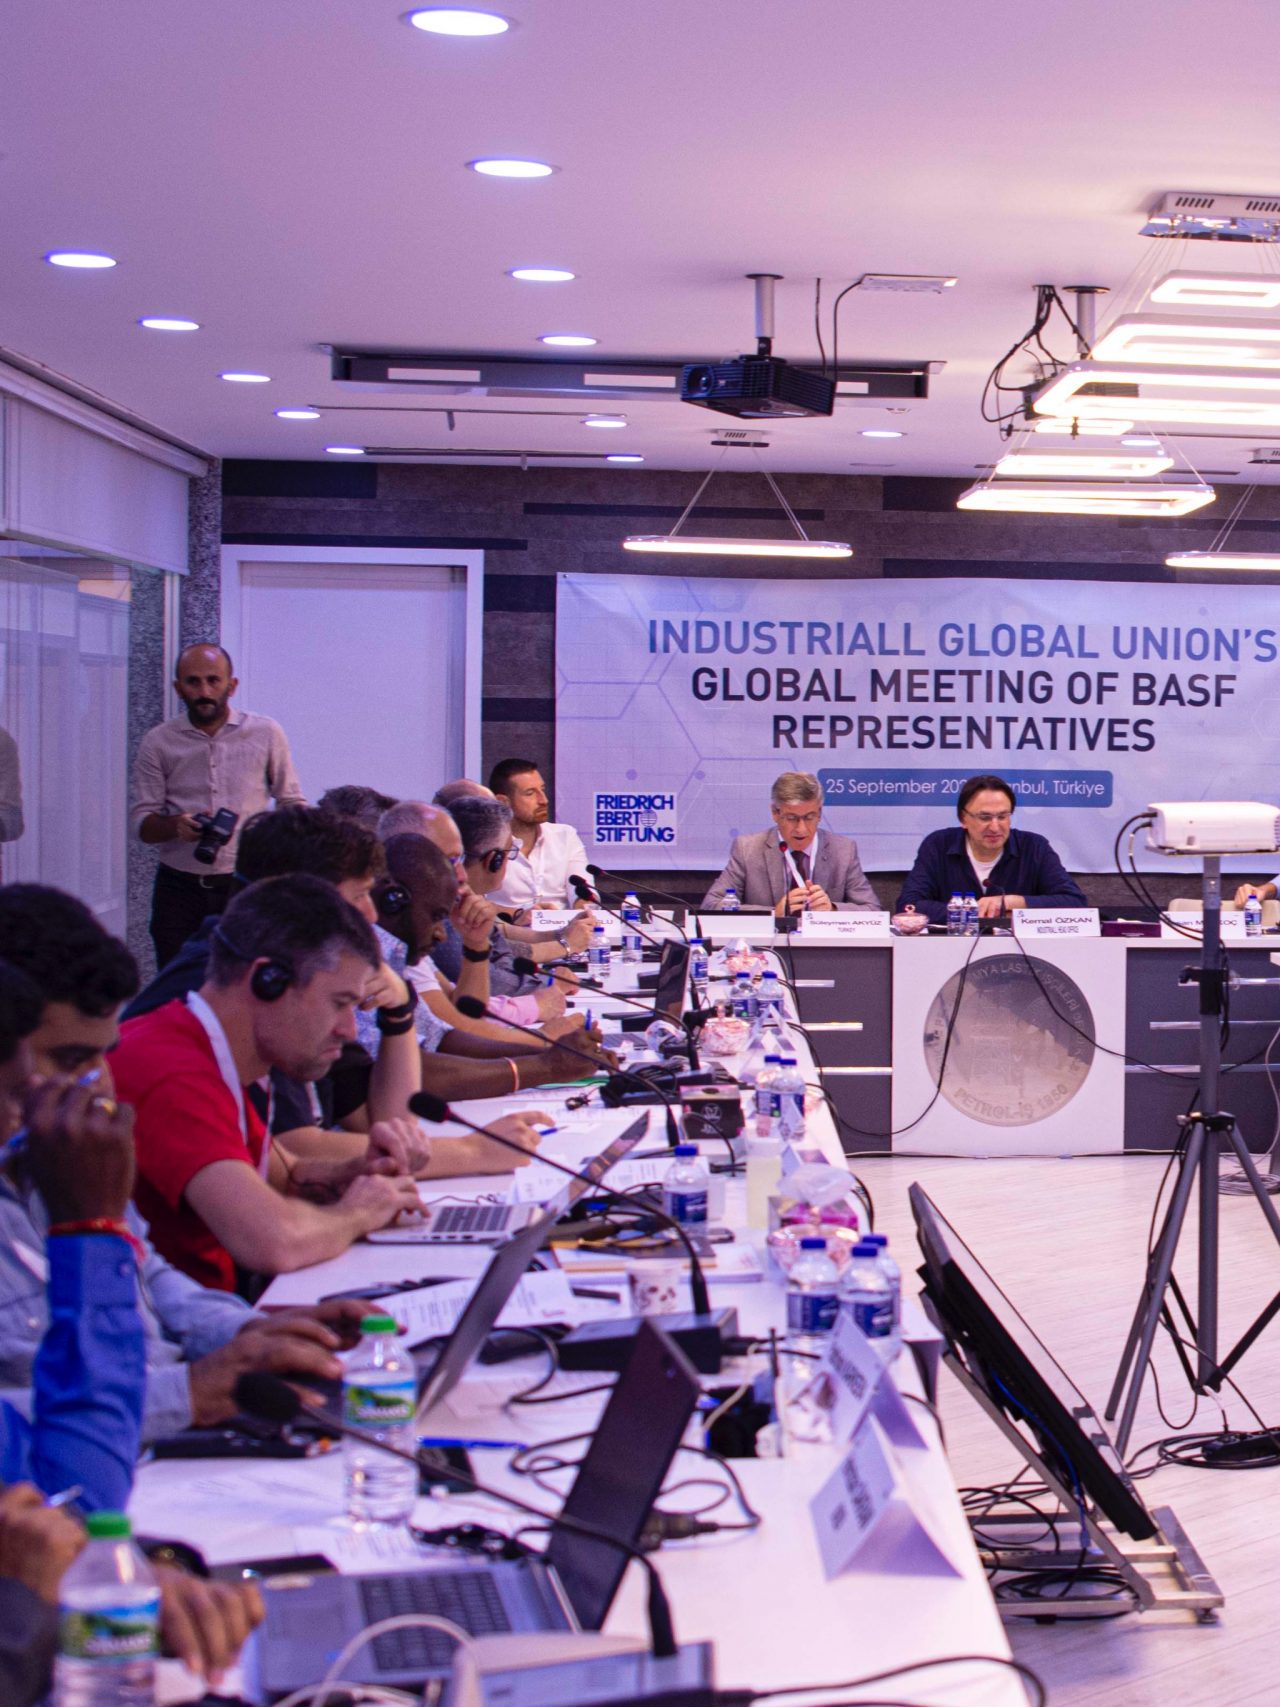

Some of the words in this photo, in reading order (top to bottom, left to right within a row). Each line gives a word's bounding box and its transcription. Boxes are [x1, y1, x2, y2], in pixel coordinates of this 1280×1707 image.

[649, 619, 926, 656] INDUSTRIALL
[938, 623, 1100, 659] GLOBAL
[1112, 626, 1278, 662] UNION'S
[692, 666, 856, 702] GLOBAL
[870, 668, 1054, 704] MEETING
[1067, 671, 1119, 705] OF
[1132, 672, 1237, 707] BASF
[772, 714, 1156, 752] REPRESENTATIVES
[826, 779, 844, 794] 25
[849, 778, 937, 800] September
[1053, 780, 1105, 798] Türkiye
[596, 794, 674, 810] FRIEDRICH
[596, 811, 641, 826] EBERT
[596, 826, 675, 842] STIFTUNG
